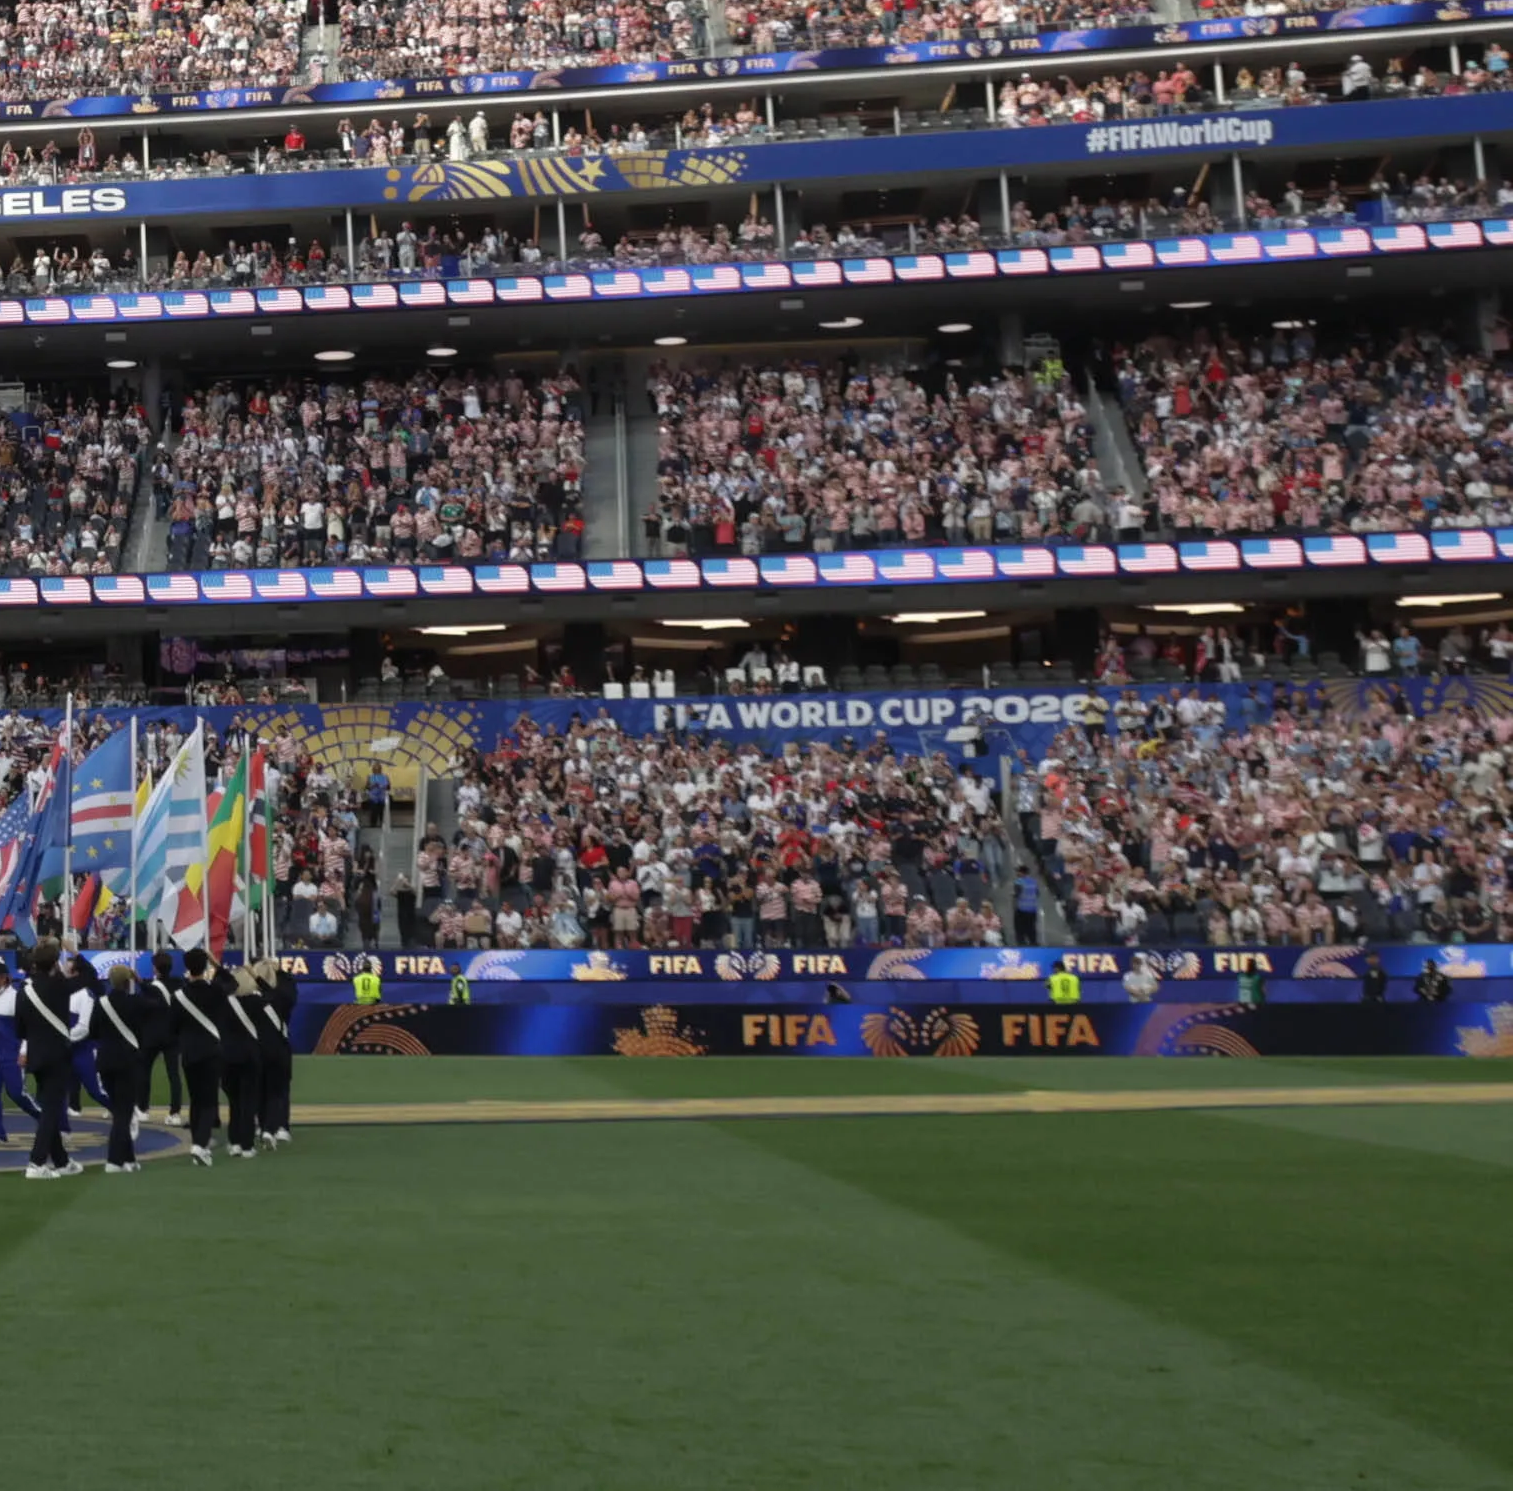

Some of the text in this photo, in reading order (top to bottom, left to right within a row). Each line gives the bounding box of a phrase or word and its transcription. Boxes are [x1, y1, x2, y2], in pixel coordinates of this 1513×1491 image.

[1285, 16, 1317, 28] FIFA
[1201, 23, 1233, 35] FIFA
[929, 44, 959, 56] FIFA
[1009, 38, 1041, 50] FIFA
[668, 63, 697, 75] FIFA
[746, 58, 777, 69] FIFA
[415, 81, 444, 92] FIFA
[491, 76, 519, 87] FIFA
[172, 96, 199, 107] FIFA
[245, 91, 272, 102] FIFA
[6, 105, 33, 115] FIFA
[1086, 117, 1272, 152] #FIFAWorldCup
[737, 700, 872, 729] WORLD
[880, 698, 956, 726] CUP
[395, 956, 446, 974] FIFA
[650, 955, 702, 974] FIFA
[793, 955, 846, 974] FIFA
[1063, 954, 1118, 973] FIFA
[1215, 953, 1272, 973] FIFA
[743, 1014, 837, 1046] FIFA
[1002, 1014, 1098, 1046] FIFA
